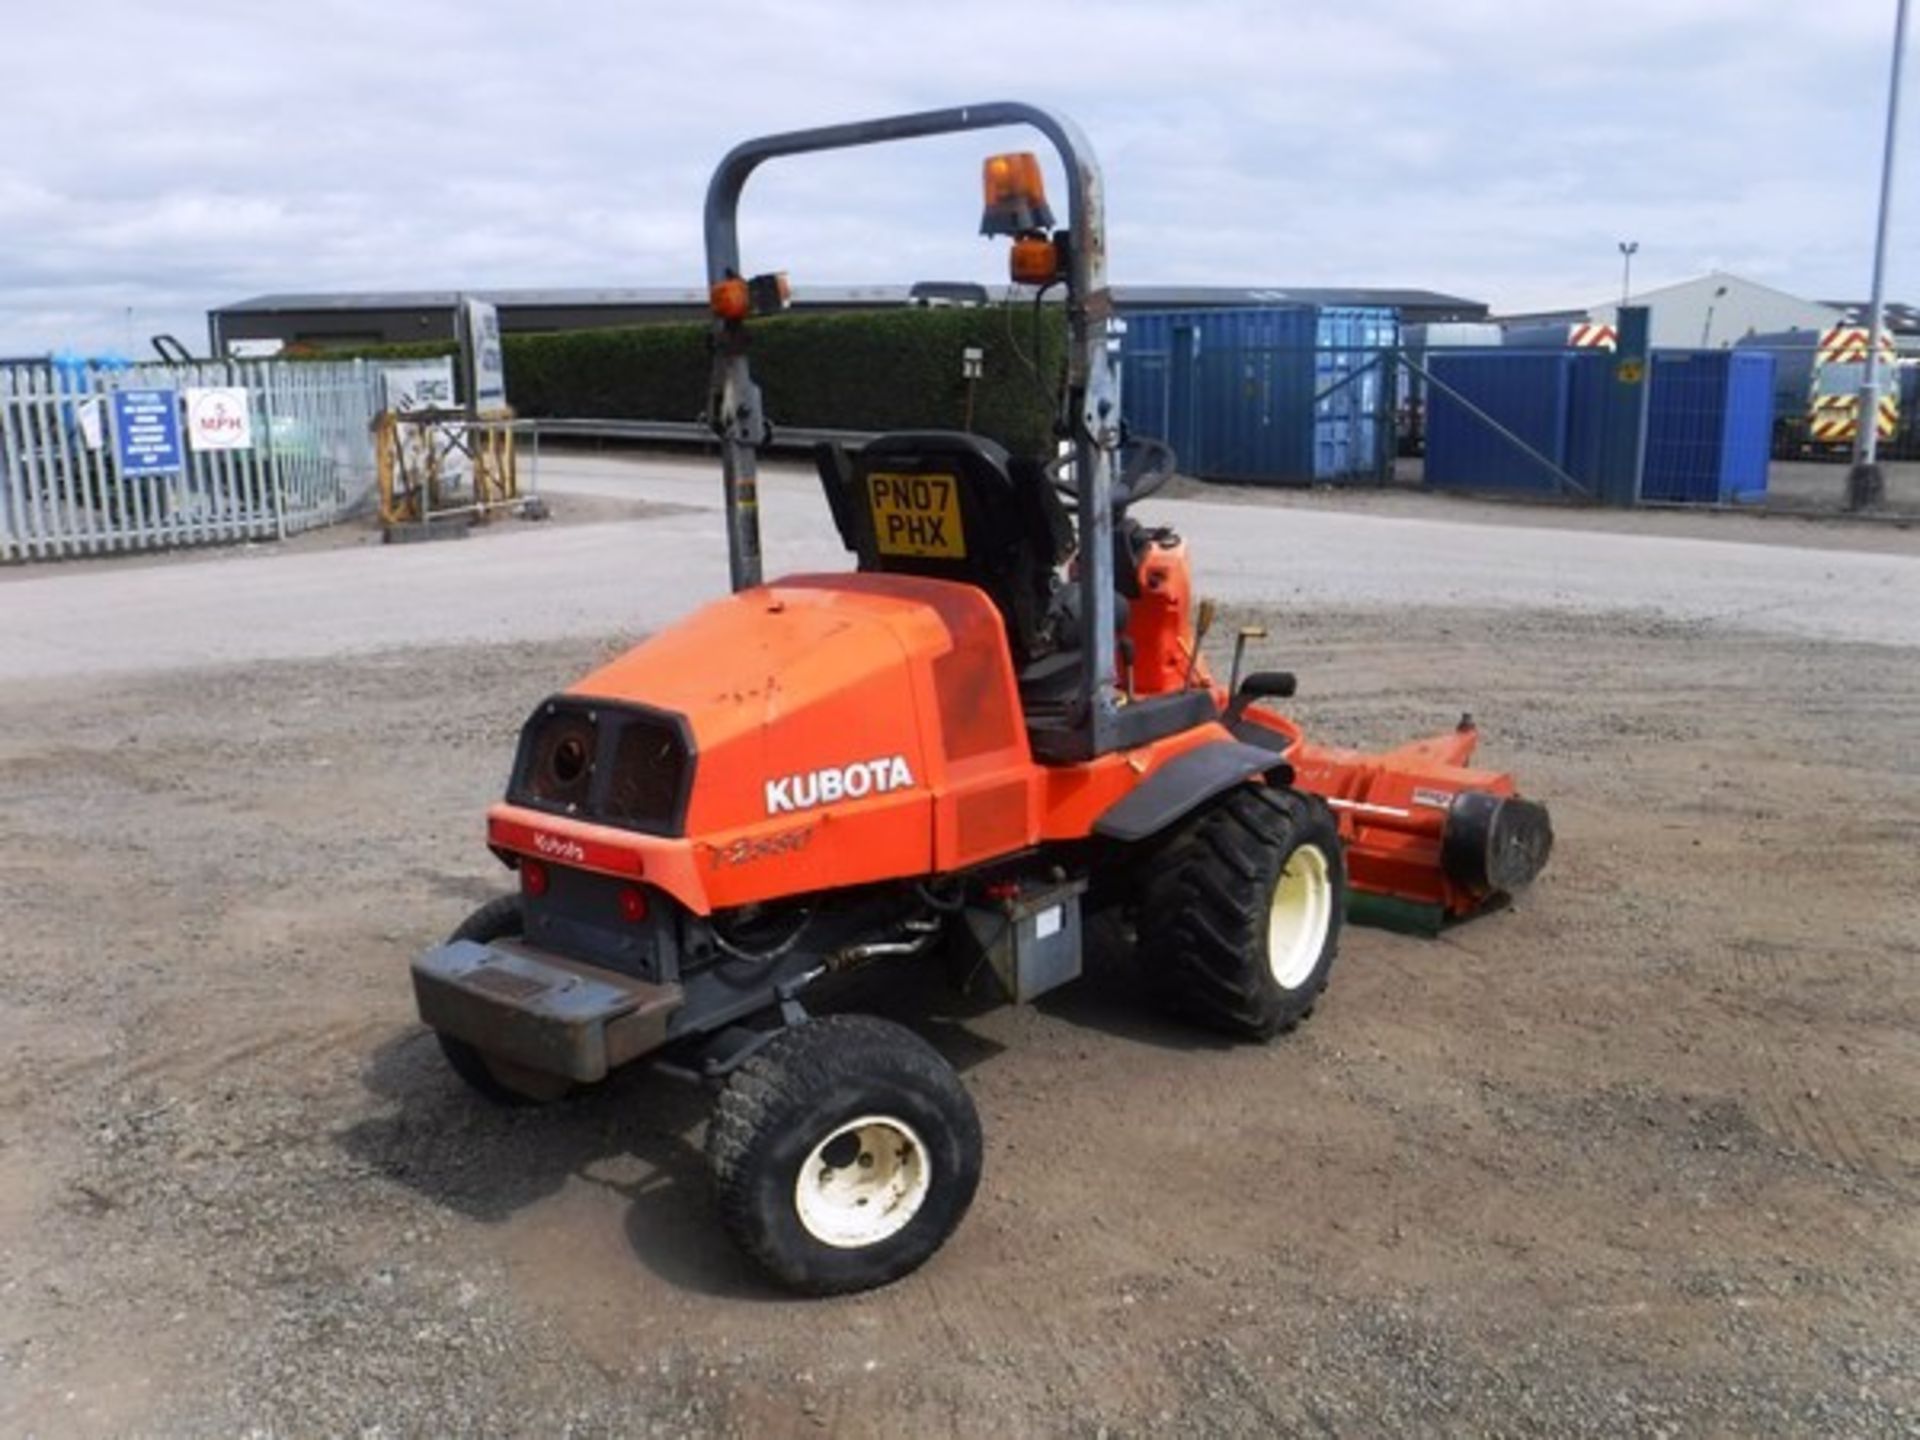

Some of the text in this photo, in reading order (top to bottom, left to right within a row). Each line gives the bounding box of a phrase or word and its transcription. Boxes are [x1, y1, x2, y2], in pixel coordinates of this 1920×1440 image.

[873, 480, 949, 511] PN07
[887, 514, 948, 548] PHX
[765, 755, 914, 815] KUBOTA
[533, 831, 585, 863] Kubota
